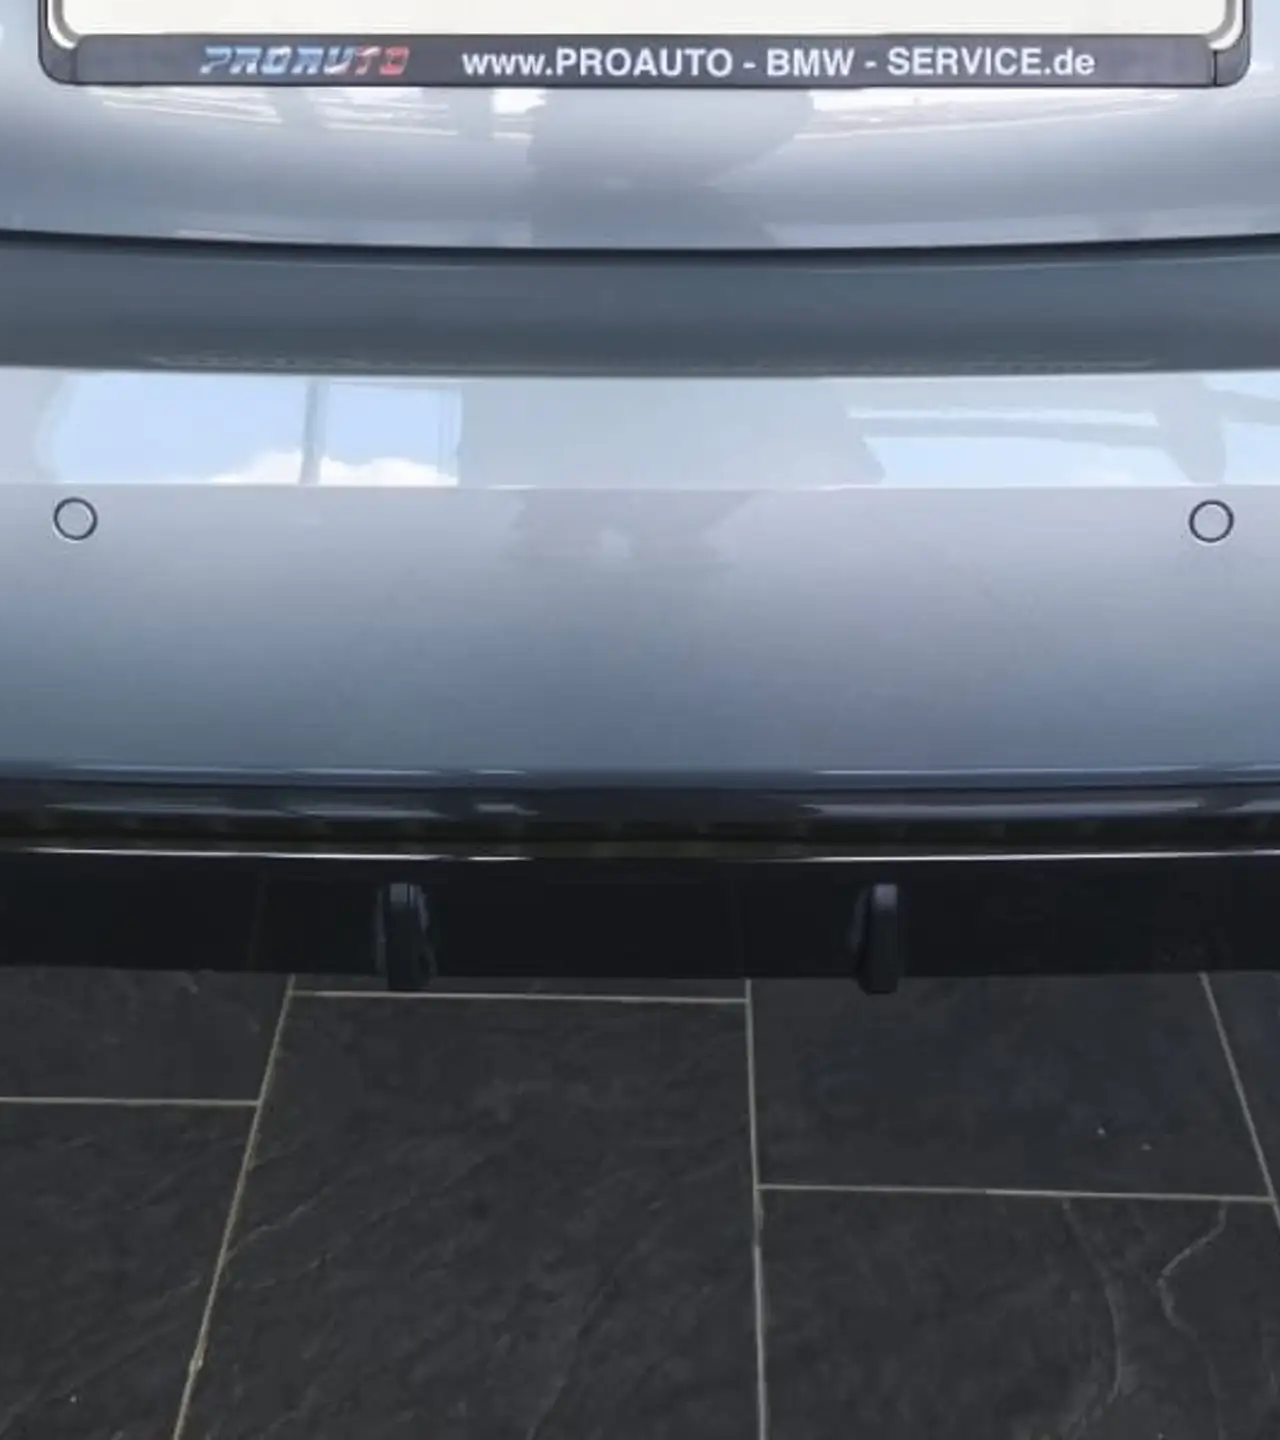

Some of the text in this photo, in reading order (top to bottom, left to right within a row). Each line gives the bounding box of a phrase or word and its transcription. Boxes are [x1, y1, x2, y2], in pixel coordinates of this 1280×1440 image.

[462, 48, 733, 77] www.PROAUTO
[766, 49, 855, 77] BMW
[887, 47, 1096, 76] SERVICE.de
